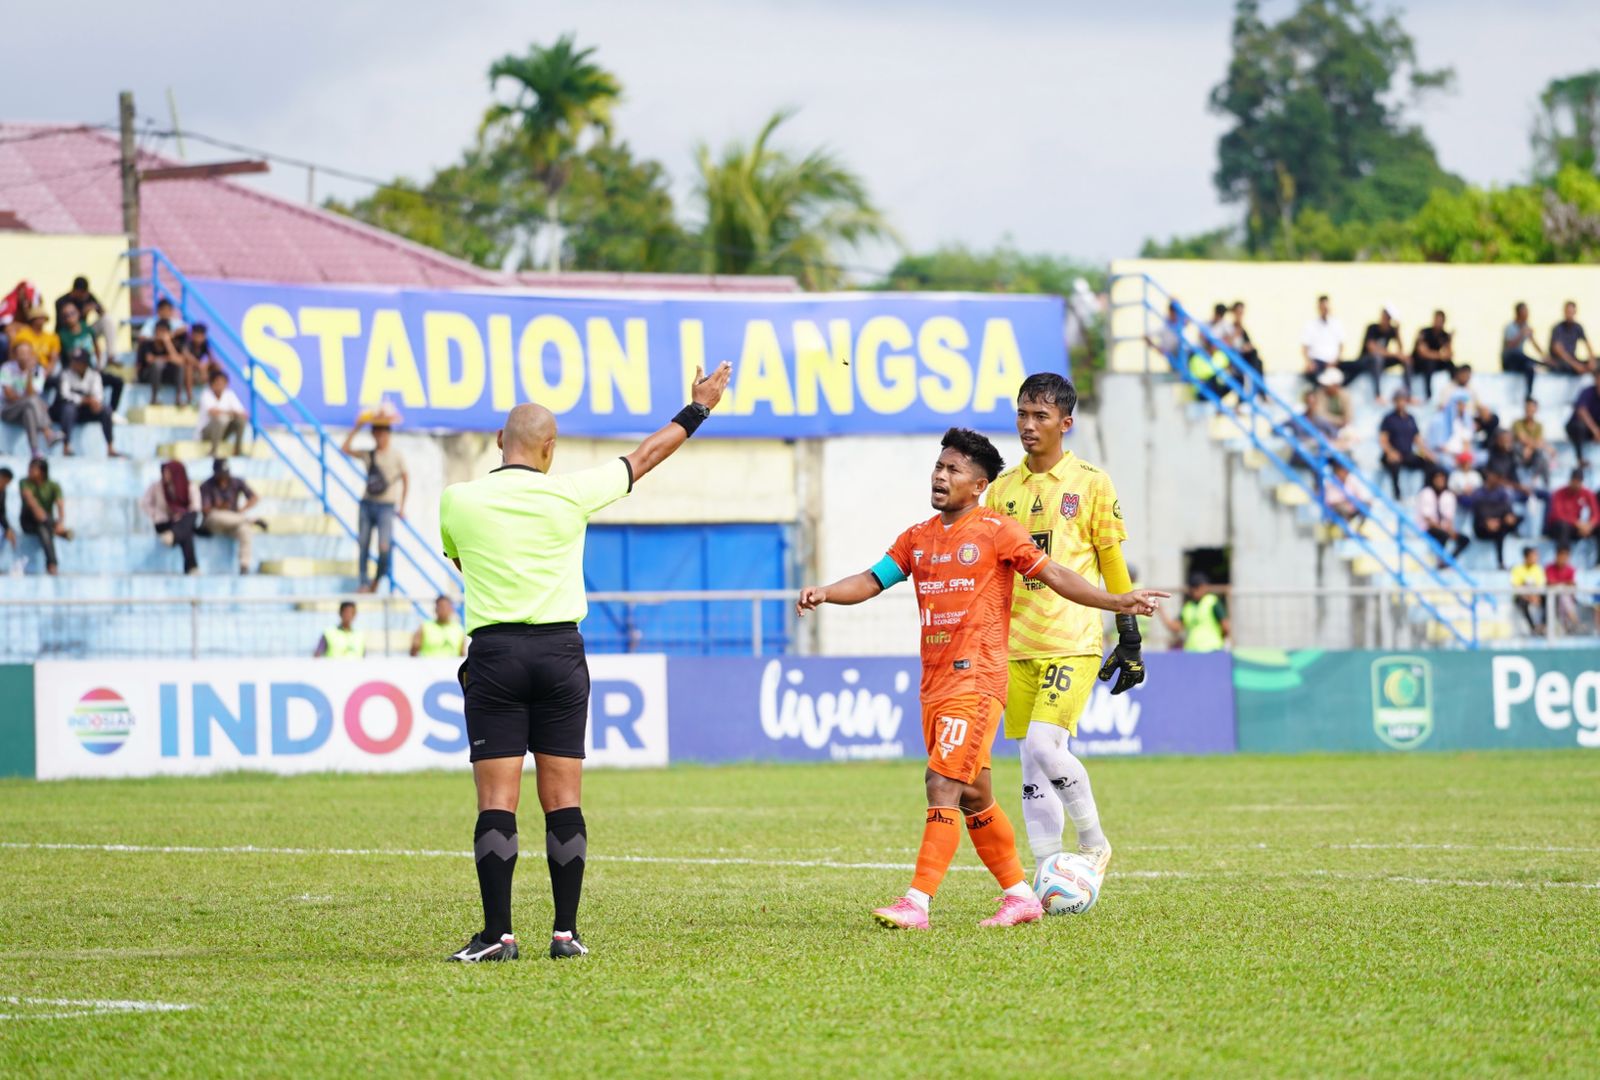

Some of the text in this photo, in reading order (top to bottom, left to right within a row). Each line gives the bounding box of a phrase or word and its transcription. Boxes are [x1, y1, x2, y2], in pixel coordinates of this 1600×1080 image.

[241, 303, 1026, 415] STADION LANGSA
[1041, 663, 1075, 692] 96
[159, 680, 647, 757] INDOSR
[939, 716, 969, 747] 70
